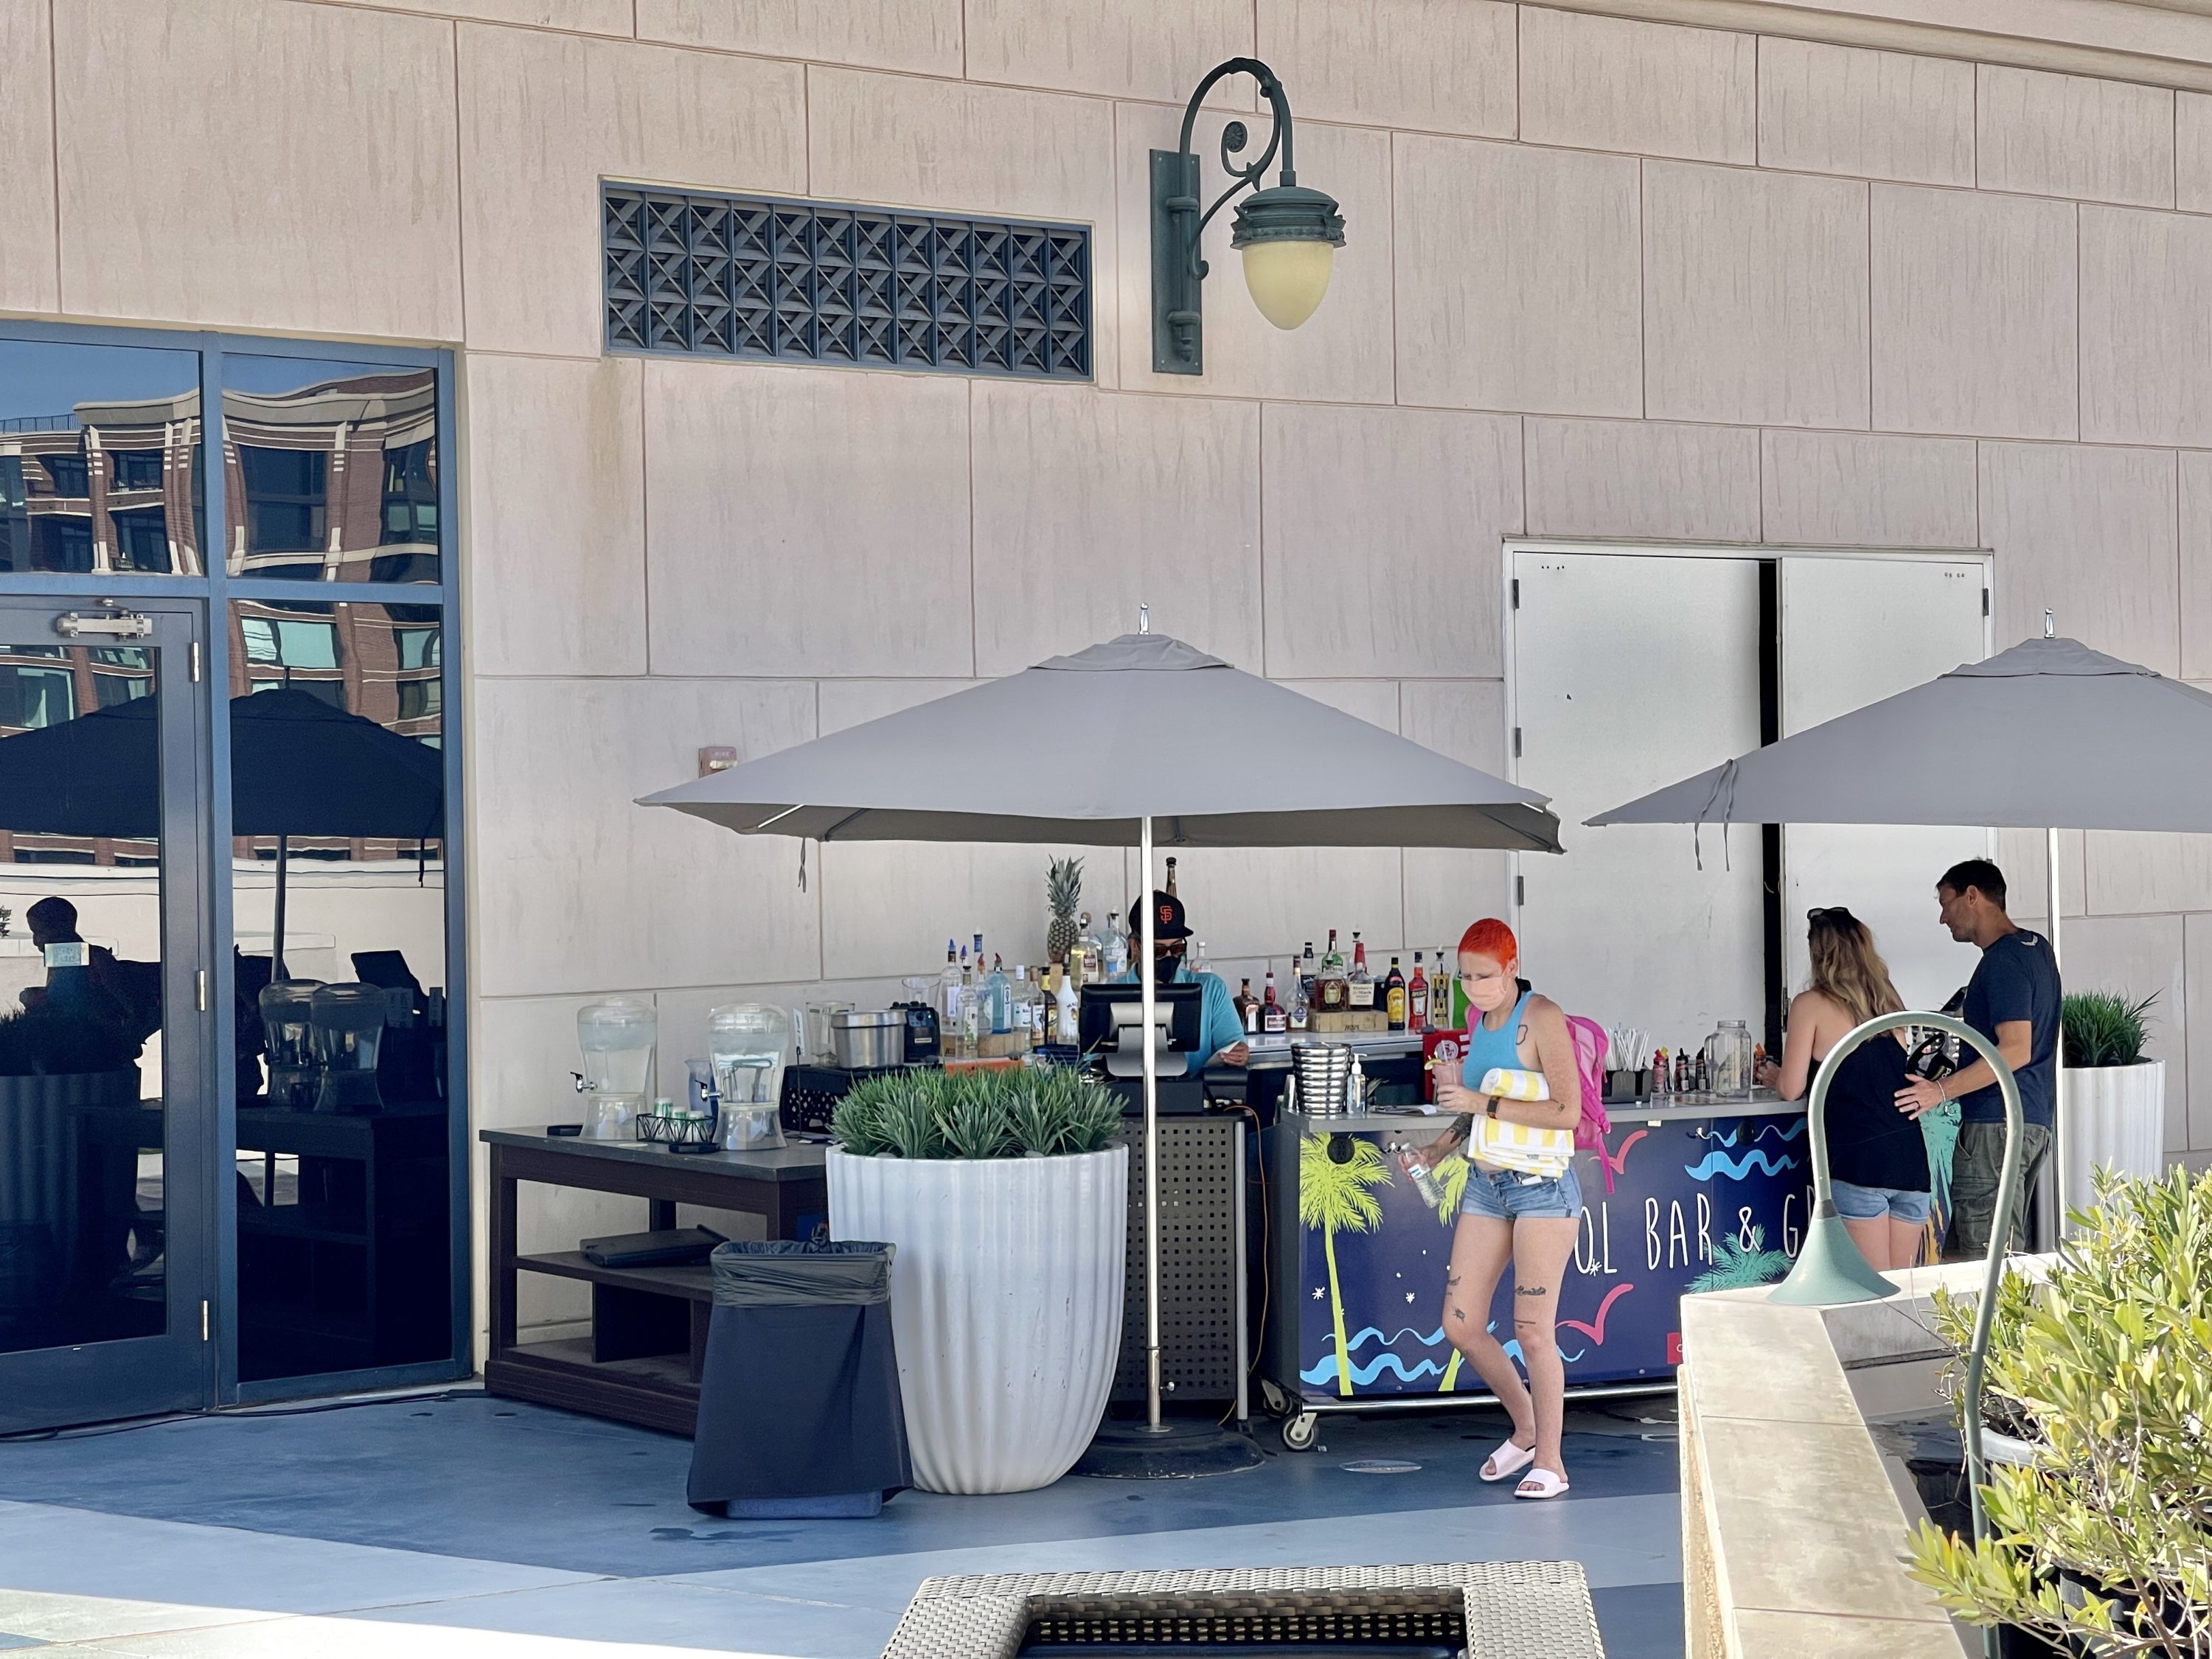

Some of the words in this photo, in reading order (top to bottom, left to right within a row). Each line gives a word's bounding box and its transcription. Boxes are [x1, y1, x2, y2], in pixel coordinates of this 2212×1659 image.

[1574, 1201, 1618, 1274] OL
[1645, 1192, 1713, 1270] BAR
[1739, 1206, 1761, 1253] &
